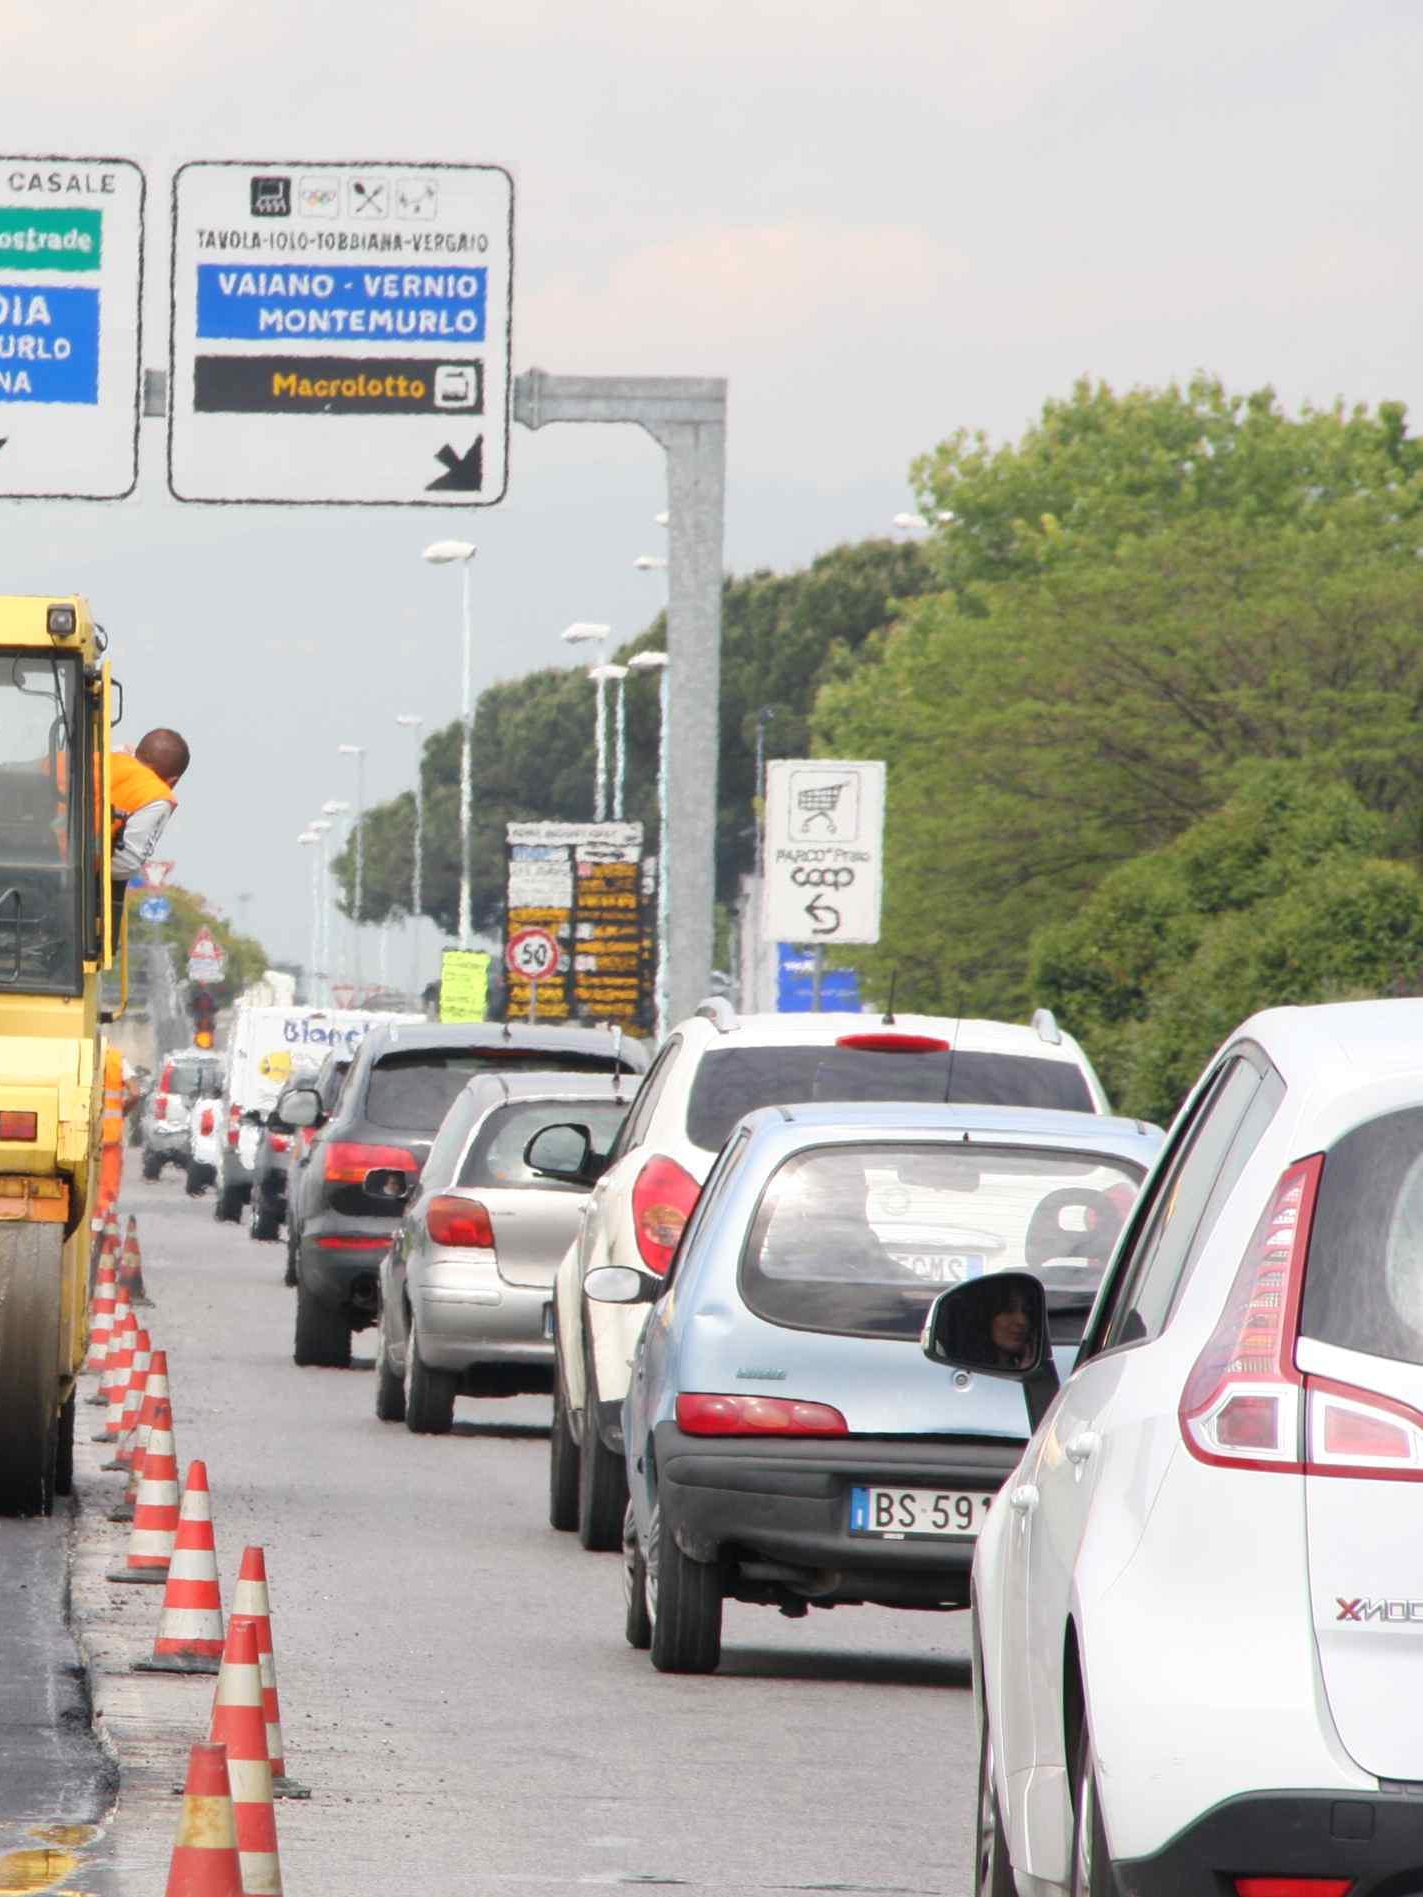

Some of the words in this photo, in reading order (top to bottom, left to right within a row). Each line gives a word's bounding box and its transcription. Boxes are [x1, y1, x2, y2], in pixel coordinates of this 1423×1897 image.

[8, 172, 116, 194] CASALE
[218, 272, 334, 298] VAIANO
[363, 274, 478, 298] VERNIO
[259, 309, 478, 334] MONTEMURLO
[272, 372, 426, 399] Macrolotto
[790, 866, 855, 891] coop
[522, 943, 548, 967] 50
[876, 1493, 916, 1528] BS
